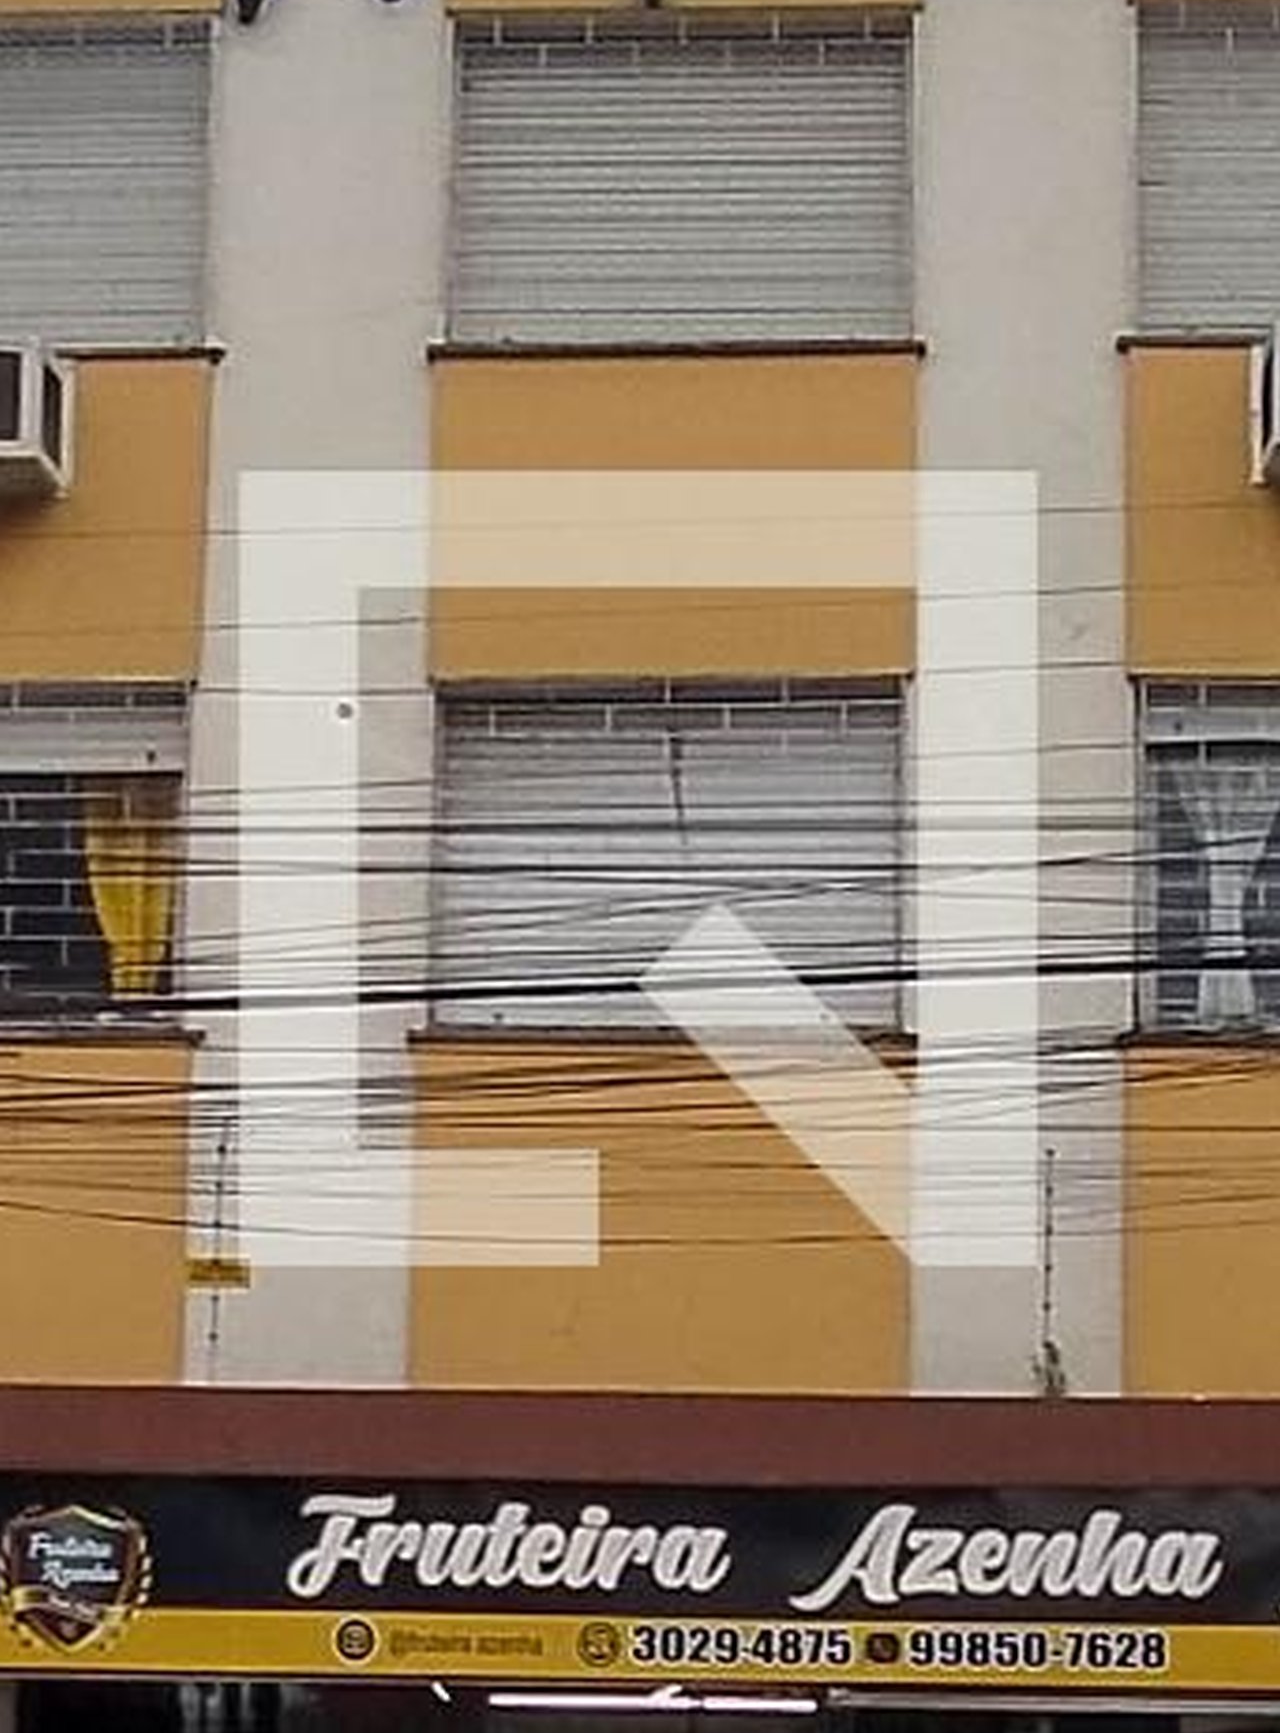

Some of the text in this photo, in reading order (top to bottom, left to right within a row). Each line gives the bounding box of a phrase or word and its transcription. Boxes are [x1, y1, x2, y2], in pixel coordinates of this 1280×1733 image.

[287, 1494, 1223, 1612] Fruteira Azenha
[631, 1624, 852, 1665] 3029-4875
[909, 1631, 1166, 1669] 99850-7628
